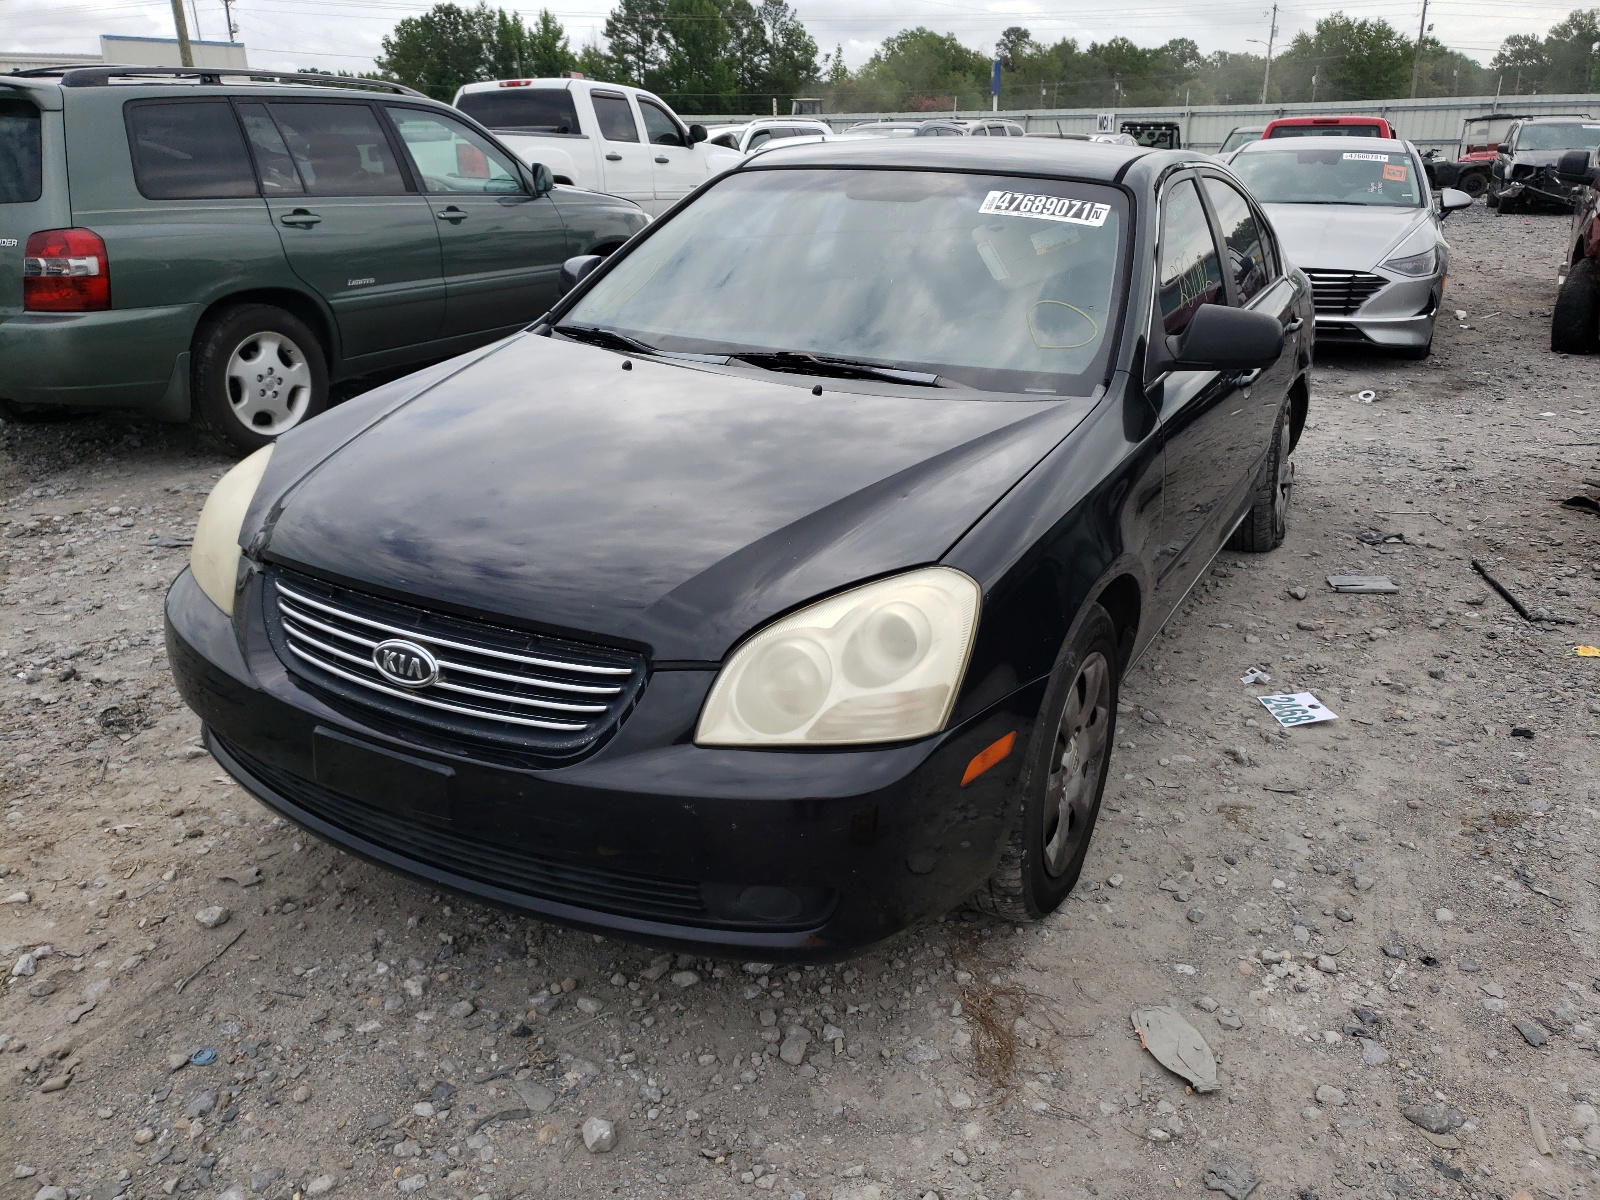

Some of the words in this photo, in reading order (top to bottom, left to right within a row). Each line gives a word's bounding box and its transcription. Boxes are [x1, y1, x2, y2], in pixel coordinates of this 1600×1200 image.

[997, 193, 1091, 220] 47689071
[0, 239, 18, 247] DER
[383, 649, 423, 679] KIA
[1262, 697, 1316, 723] 2468
